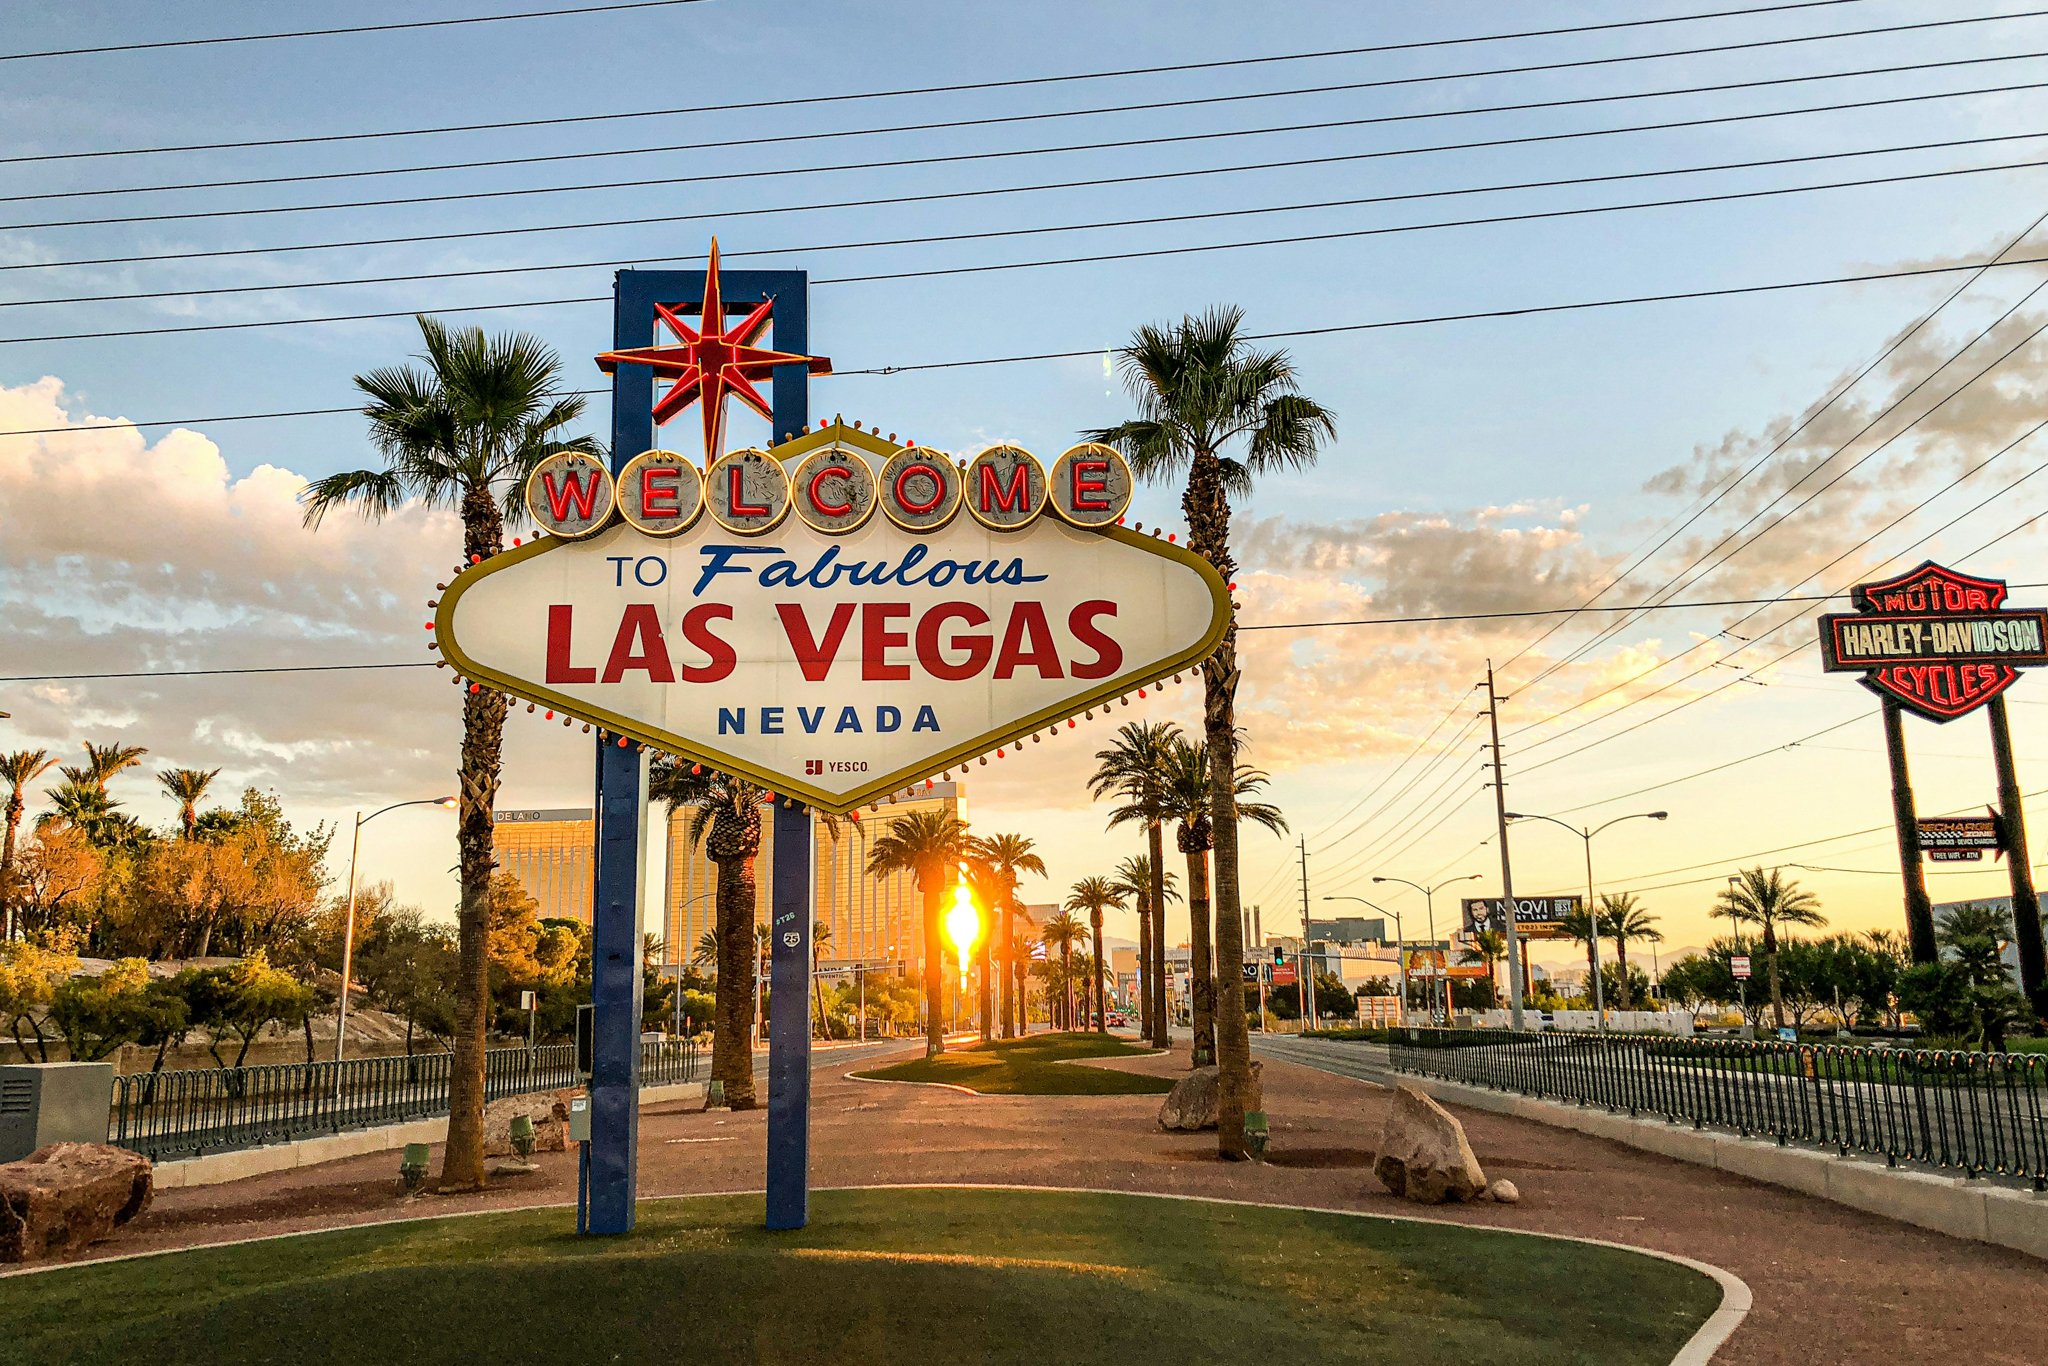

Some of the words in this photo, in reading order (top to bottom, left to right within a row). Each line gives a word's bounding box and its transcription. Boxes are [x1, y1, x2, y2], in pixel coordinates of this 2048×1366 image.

[542, 460, 1112, 523] WELCOME
[606, 557, 666, 587] TO
[694, 545, 1048, 597] Fabulous
[1883, 576, 1989, 612] MOTOR
[546, 603, 737, 684] LAS
[776, 600, 1124, 682] VEGAS
[1843, 620, 2040, 656] HARLEY-DAVIDSON
[1893, 664, 1999, 706] CYCLES
[717, 704, 940, 735] NEVADA
[828, 761, 868, 773] YESCO
[497, 811, 540, 821] DELANO
